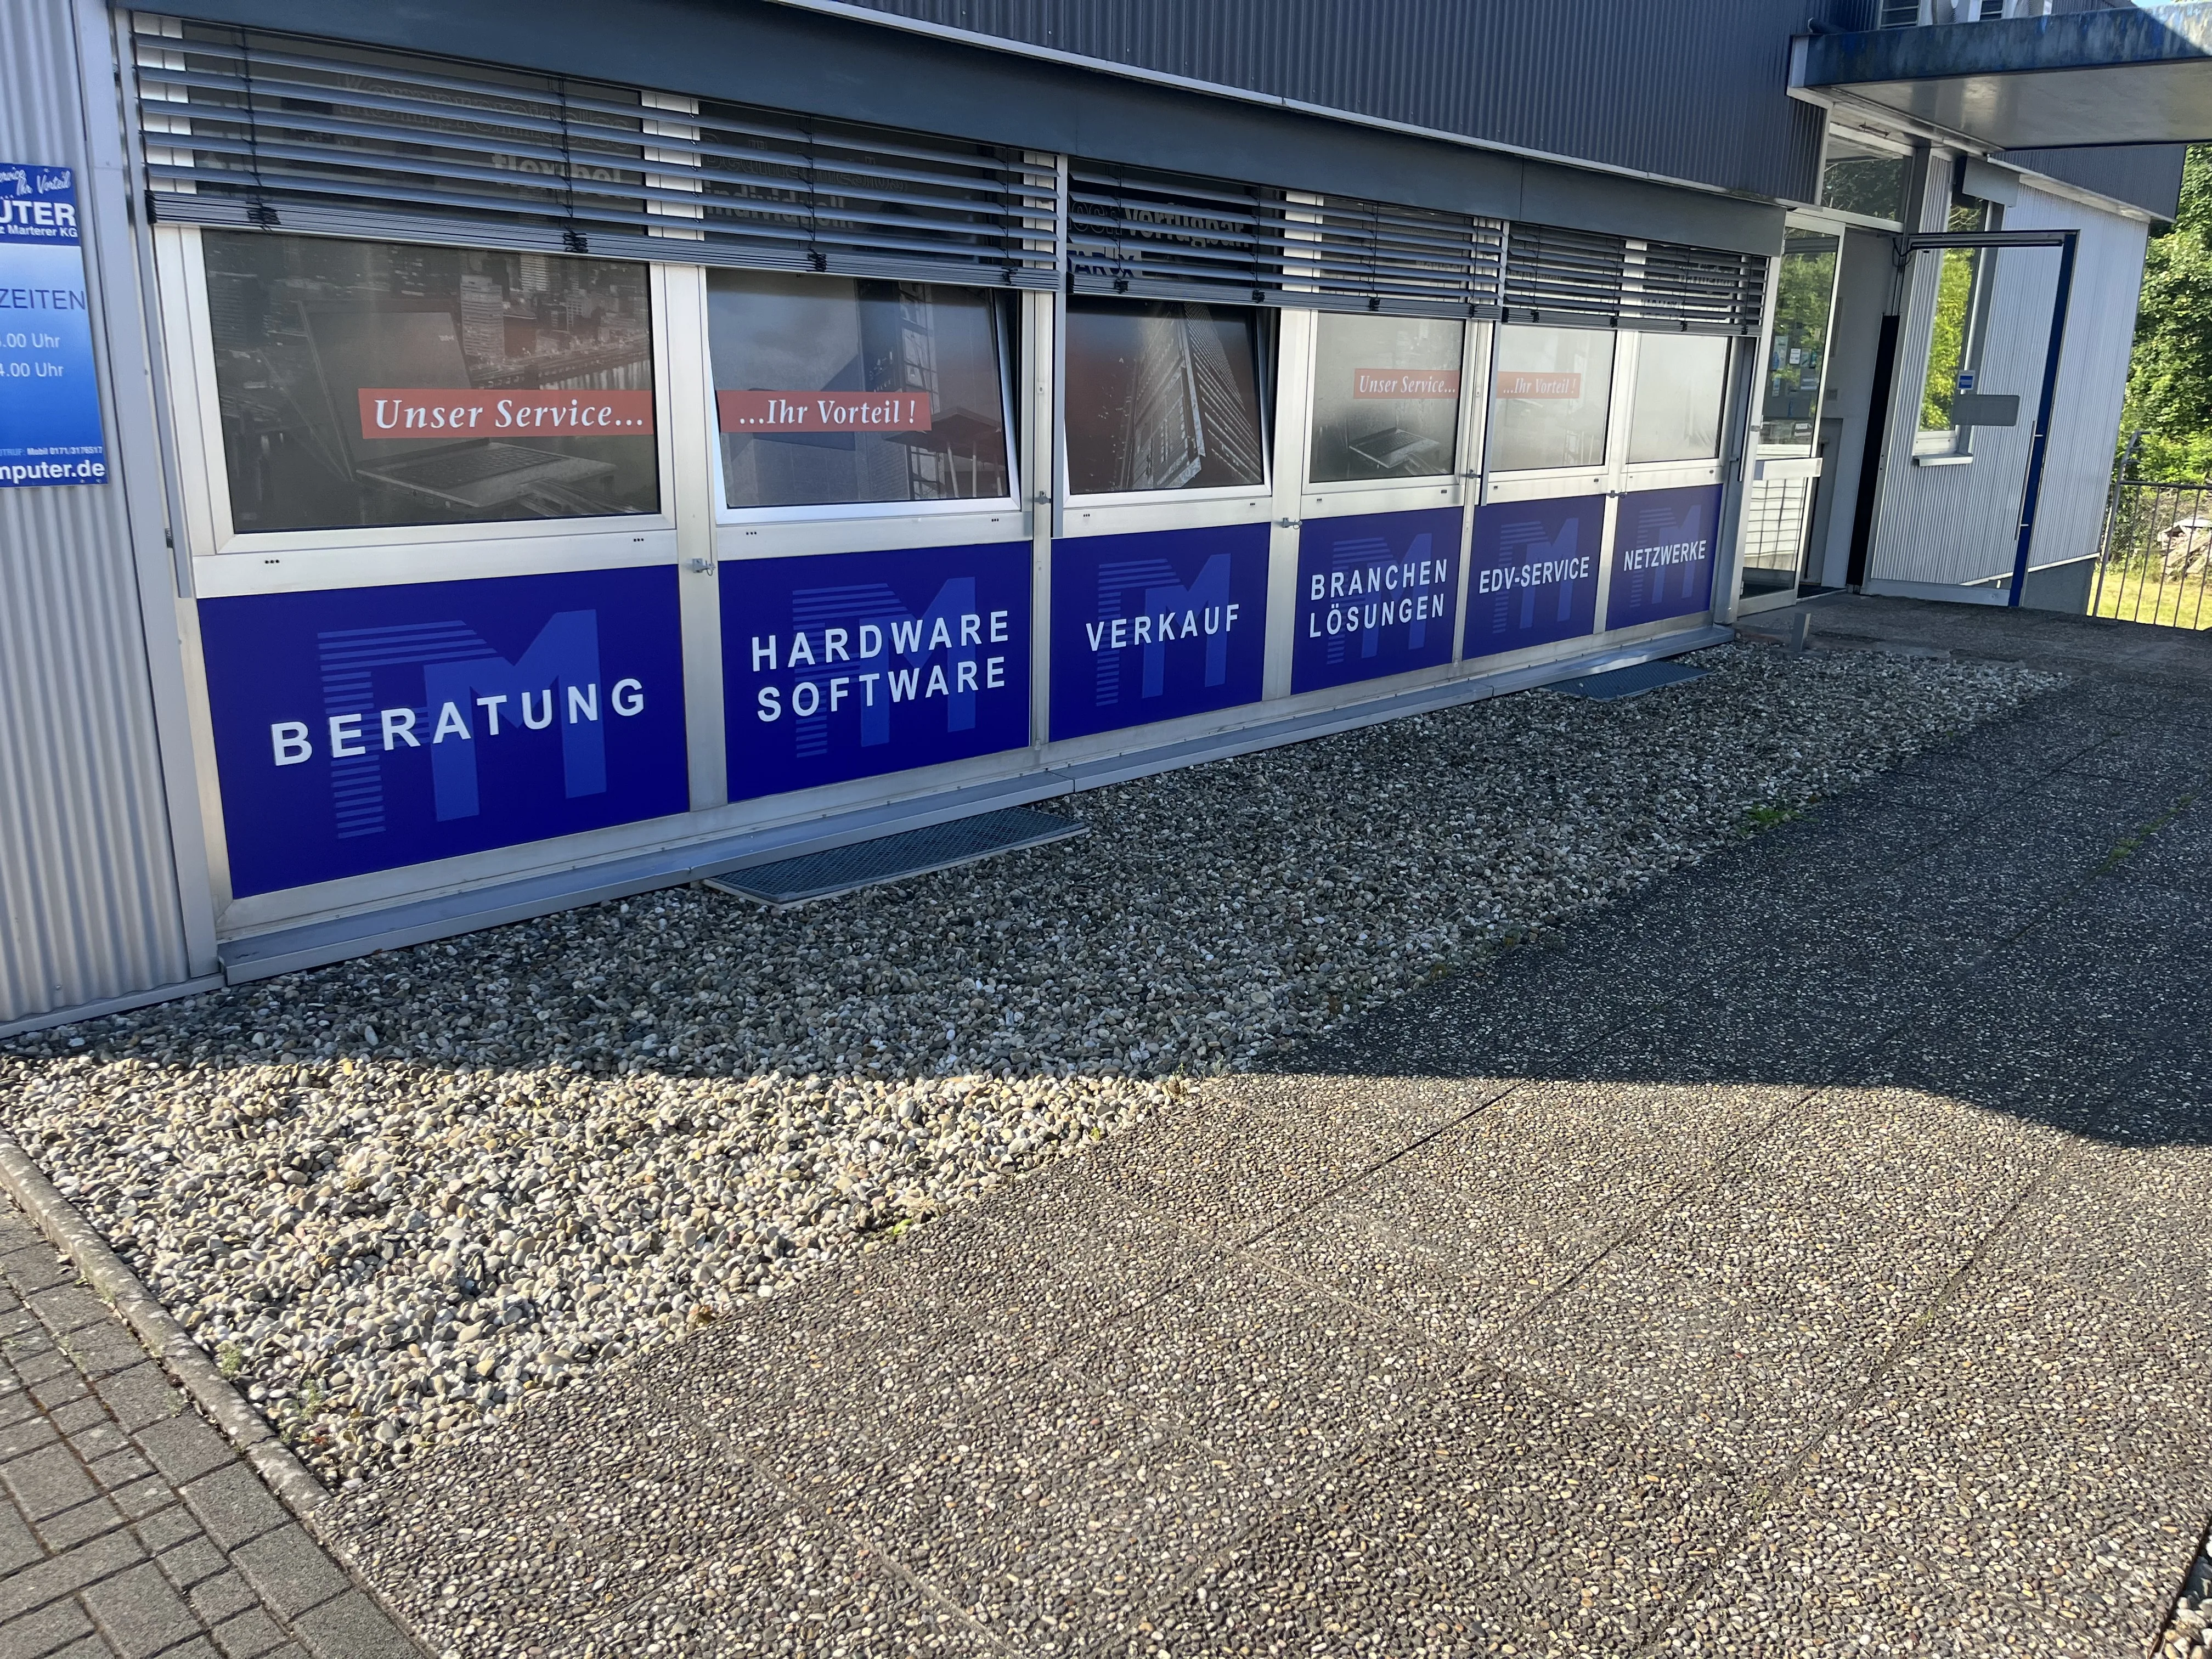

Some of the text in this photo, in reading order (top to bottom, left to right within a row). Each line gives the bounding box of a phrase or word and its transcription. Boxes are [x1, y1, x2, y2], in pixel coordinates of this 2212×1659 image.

[7, 224, 58, 236] Marterer
[60, 227, 78, 238] KG
[0, 289, 86, 310] ZEITEN
[31, 333, 61, 348] Uhr
[35, 362, 64, 377] Uhr
[1359, 375, 1456, 393] Unser Service...
[1536, 378, 1570, 394] Vorteil
[375, 399, 643, 429] Unser Service...
[740, 399, 808, 425] ...Ihr
[817, 400, 900, 425] Vorteil
[27, 447, 48, 455] Mobil
[1623, 540, 1707, 572] NETZWERKE
[1311, 558, 1447, 601] BRANCHEN
[1479, 556, 1590, 594] EDV-SERVICE
[1086, 604, 1239, 651] VERKAUF
[1310, 593, 1444, 638] LÖSUNGEN
[752, 610, 1009, 672] HARDWARE
[757, 657, 1005, 722] SOFTWARE
[271, 678, 644, 766] BERATUNG
